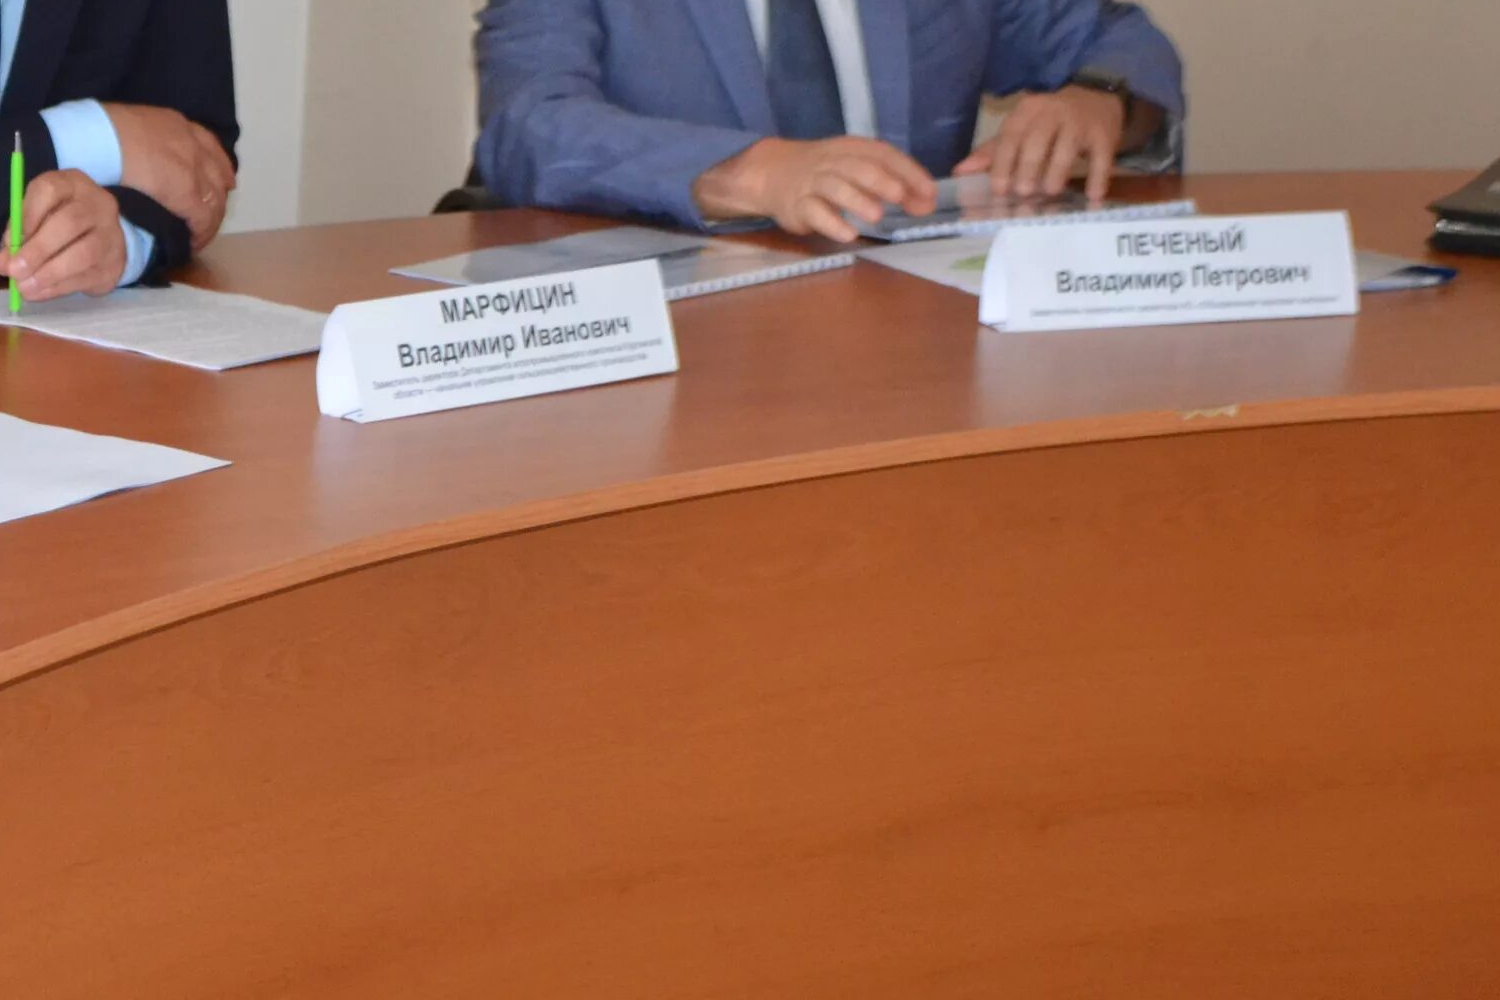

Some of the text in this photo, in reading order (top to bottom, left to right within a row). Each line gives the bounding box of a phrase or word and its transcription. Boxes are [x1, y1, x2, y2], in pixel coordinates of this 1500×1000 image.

[1115, 224, 1247, 258] ПЕЧЕНЫЙ
[1055, 263, 1312, 295] Владимир Петрович
[439, 281, 578, 325] МАРФИЦИН
[397, 332, 516, 369] Владимир
[521, 315, 632, 350] Иванович
